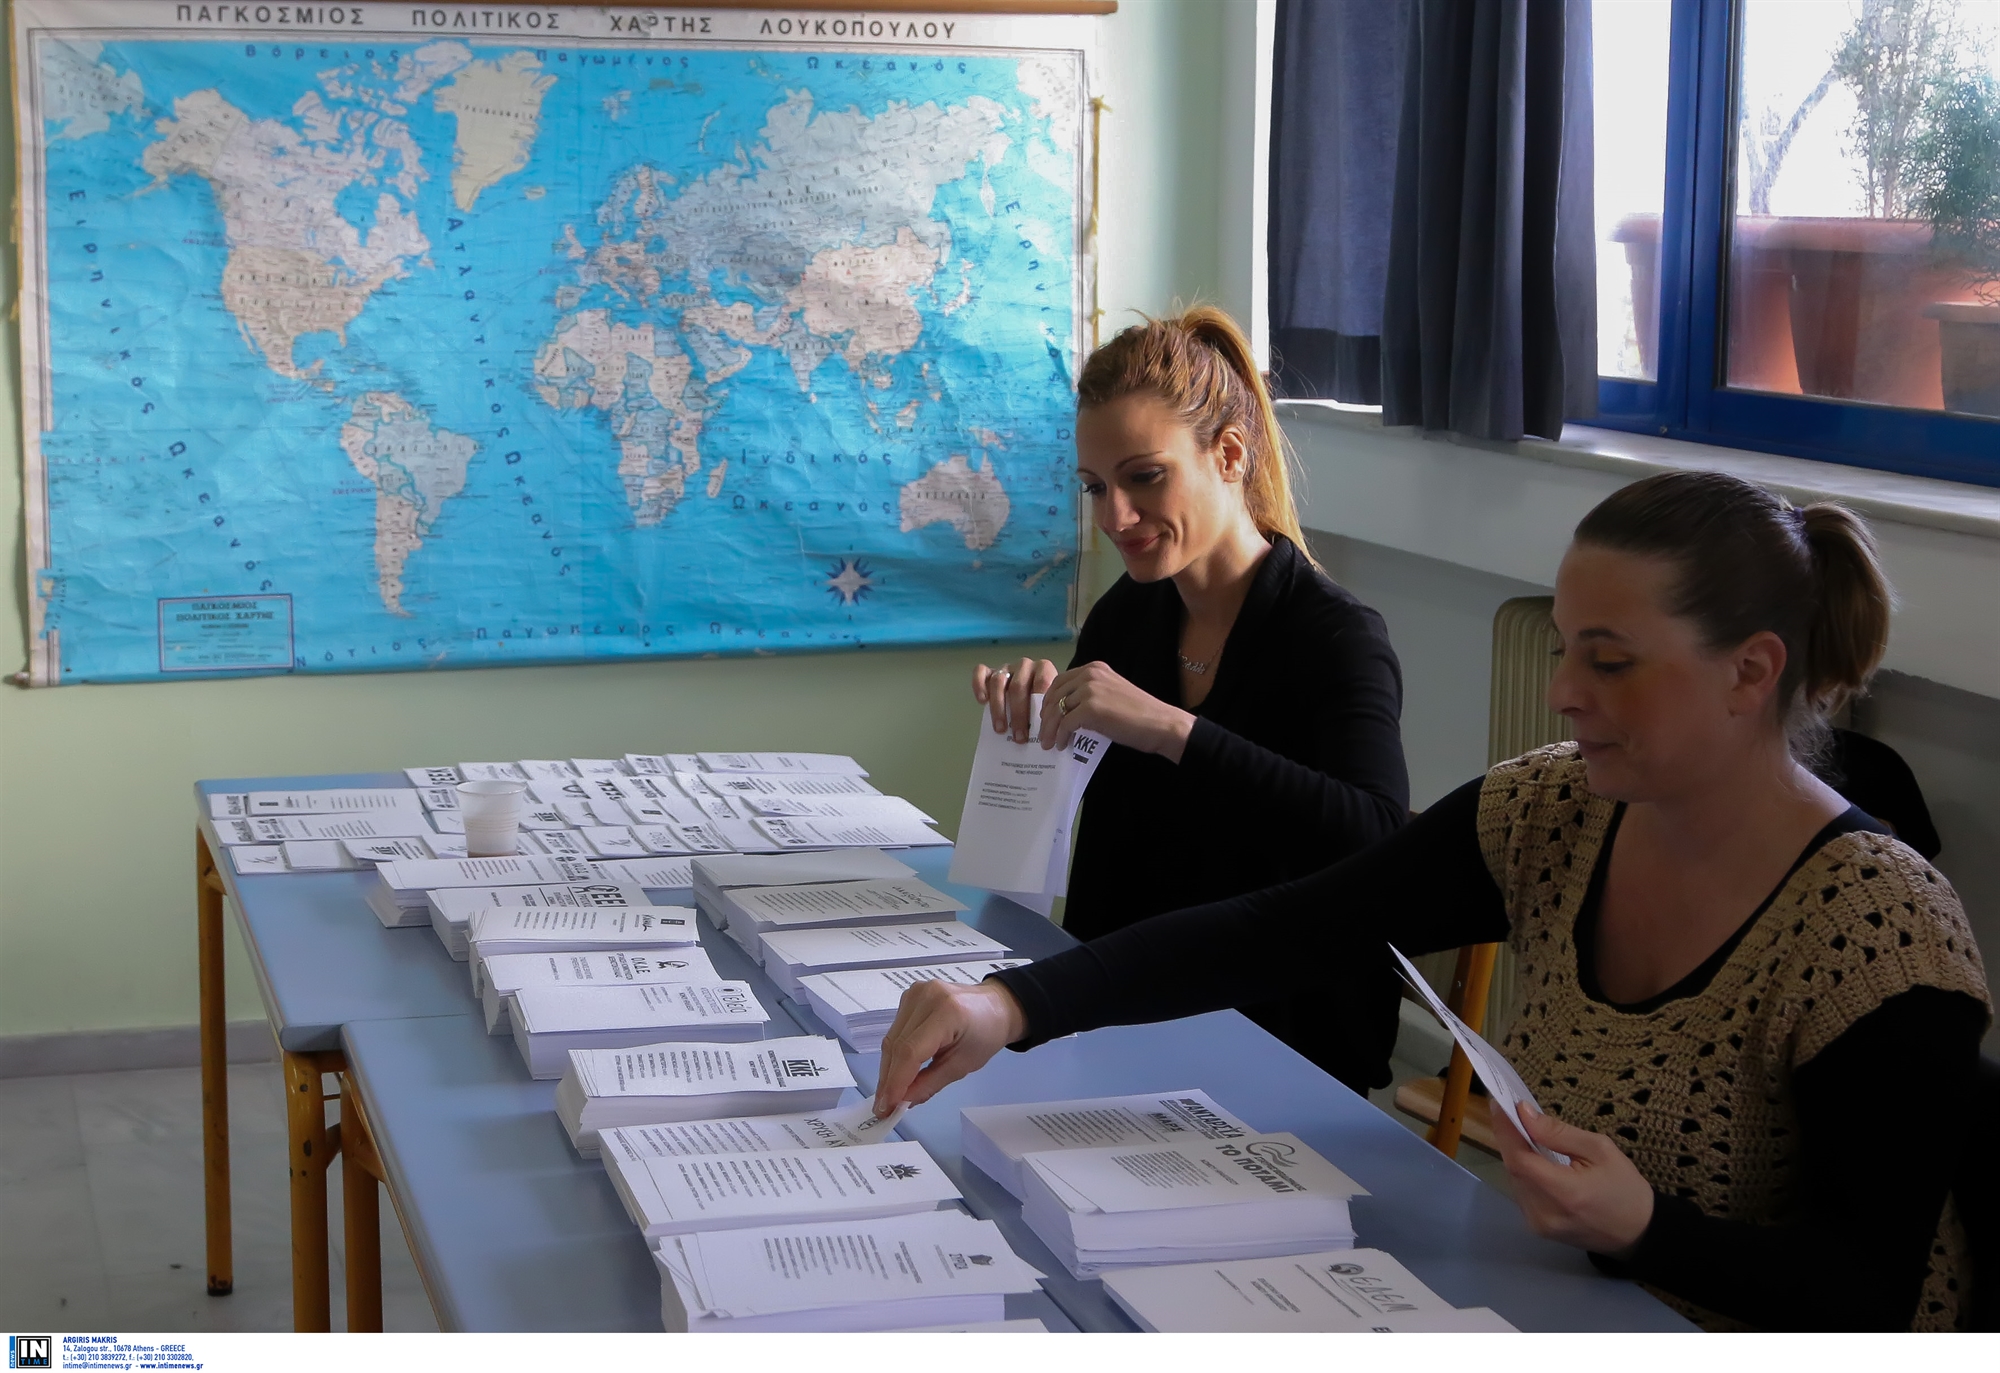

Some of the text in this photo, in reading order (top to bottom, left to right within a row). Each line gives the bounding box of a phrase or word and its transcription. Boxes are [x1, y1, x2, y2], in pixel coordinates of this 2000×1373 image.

[176, 4, 956, 40] ΠΑΓΚΟΣΜΙΟΣ ΠΟΛΙΤΙΚΟΣ ΧΑΡΤΗΣ ΛΟΥΚΟΠΟΥΛΟΥ
[806, 55, 967, 75] Ωκεανός
[741, 448, 892, 466] Ινδικός
[168, 440, 274, 593] Ωκεανός
[504, 450, 572, 578] Ωκεανός
[731, 495, 892, 516] Ωκεανός
[787, 1059, 814, 1077] ΚΚΕ
[804, 1118, 837, 1139] ΧΡΥΣΗ
[1185, 1102, 1245, 1139] ΑΝΤΑΡΣΥΑ
[1215, 1144, 1242, 1156] ΤΟ
[1233, 1157, 1295, 1193] ΠΟΤΑΜΙ
